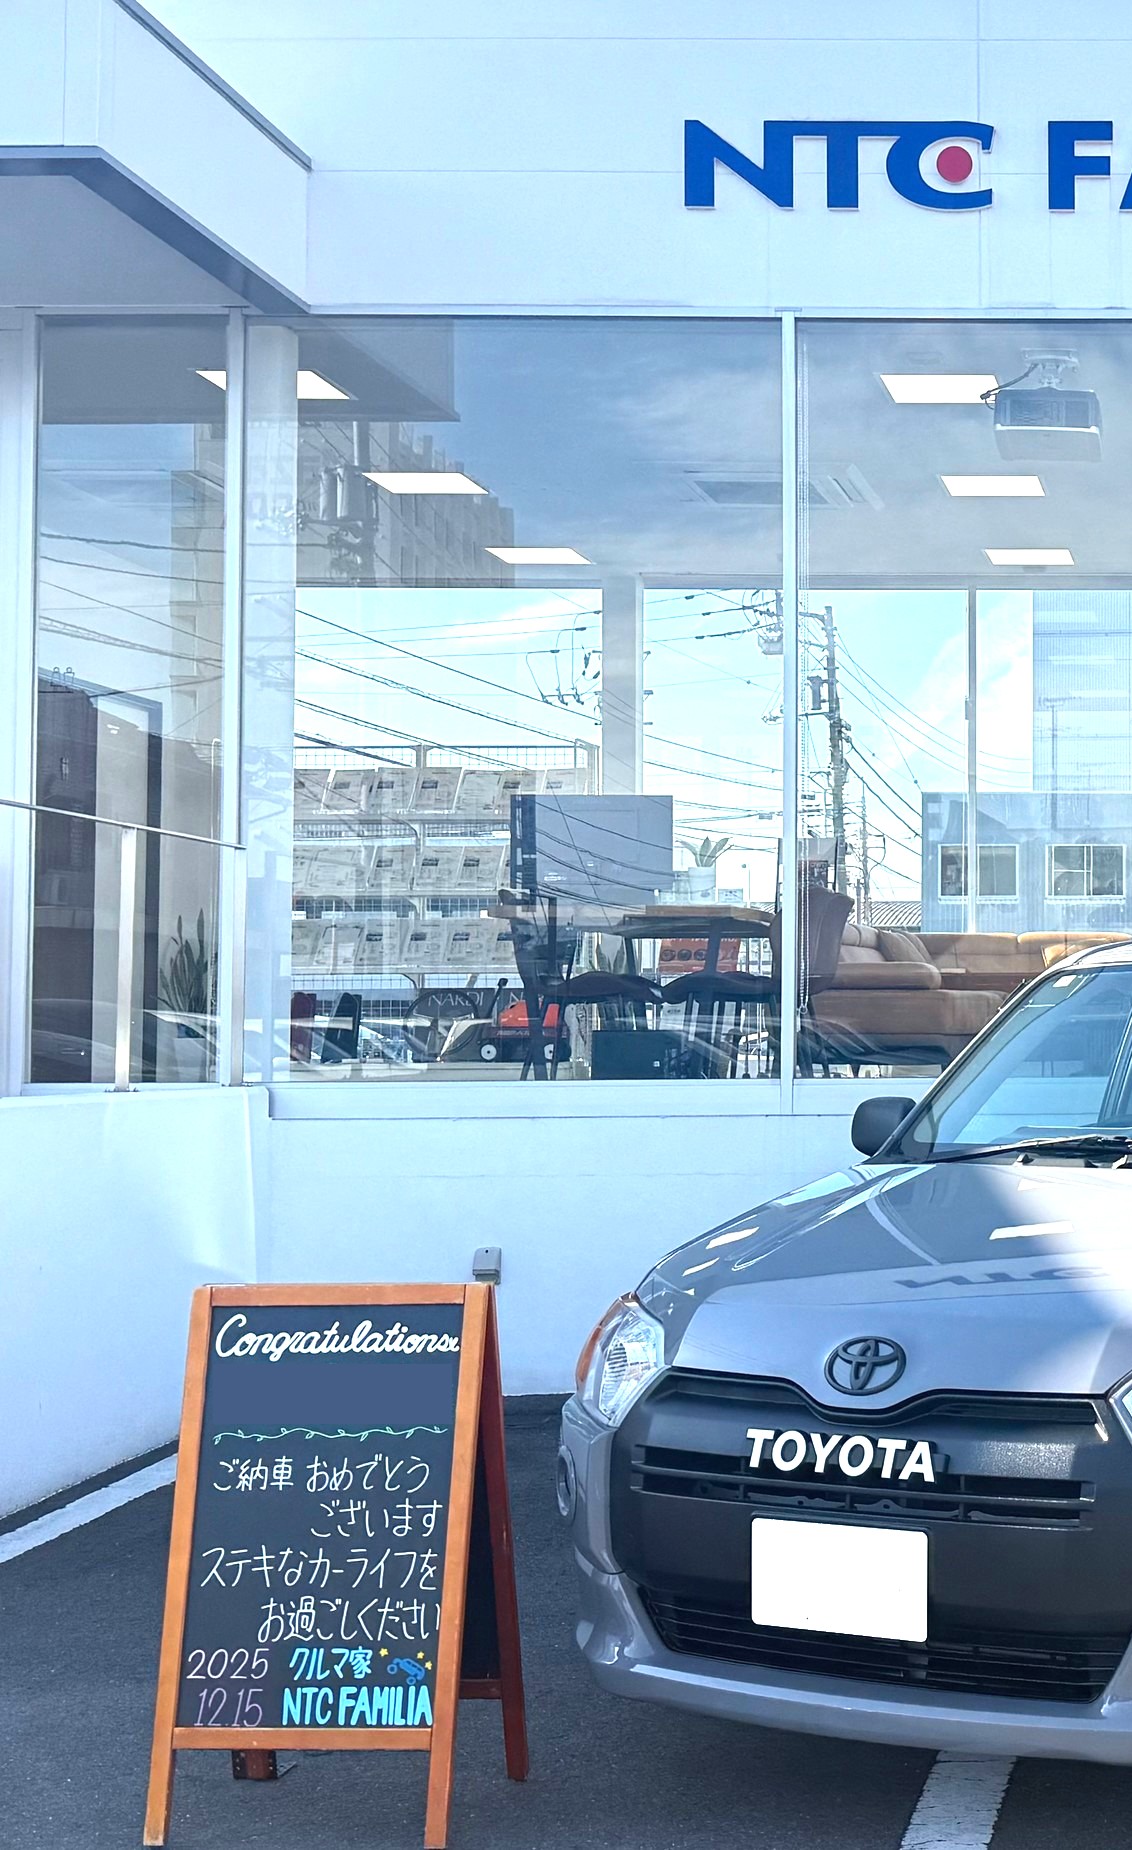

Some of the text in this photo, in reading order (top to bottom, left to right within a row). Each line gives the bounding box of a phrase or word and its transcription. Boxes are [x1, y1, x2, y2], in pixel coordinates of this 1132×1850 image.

[684, 119, 995, 210] NTC
[213, 1453, 430, 1494] ご納車 おめでとう
[746, 1428, 936, 1483] TOYOTA
[310, 1497, 444, 1538] ございます
[200, 1544, 438, 1591] ステキなカーライフを
[257, 1596, 441, 1643] お過ごしください
[186, 1647, 270, 1680] 2025
[289, 1646, 374, 1681] クルマ家
[193, 1687, 264, 1727] 12.15
[282, 1685, 433, 1726] NTC FAMILIA
